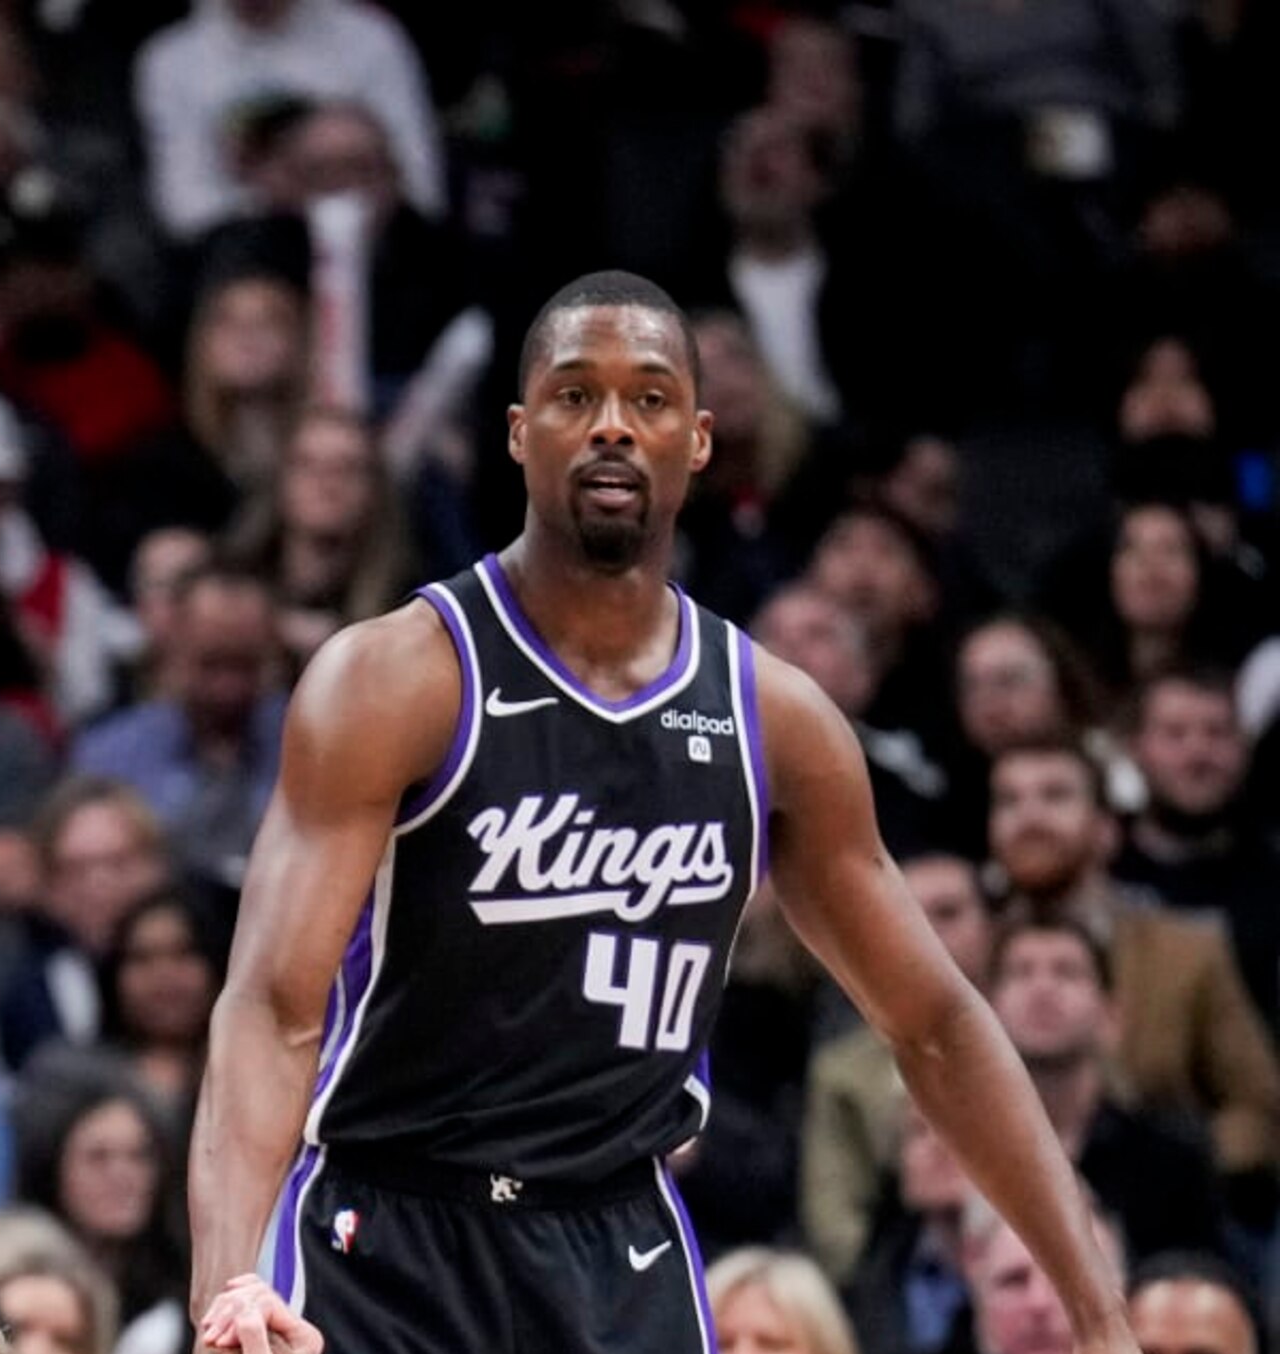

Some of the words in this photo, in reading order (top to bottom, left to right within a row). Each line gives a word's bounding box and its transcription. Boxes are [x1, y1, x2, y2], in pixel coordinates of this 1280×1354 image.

[661, 709, 734, 734] dialpad
[467, 794, 733, 924] Kings
[583, 932, 711, 1051] 40
